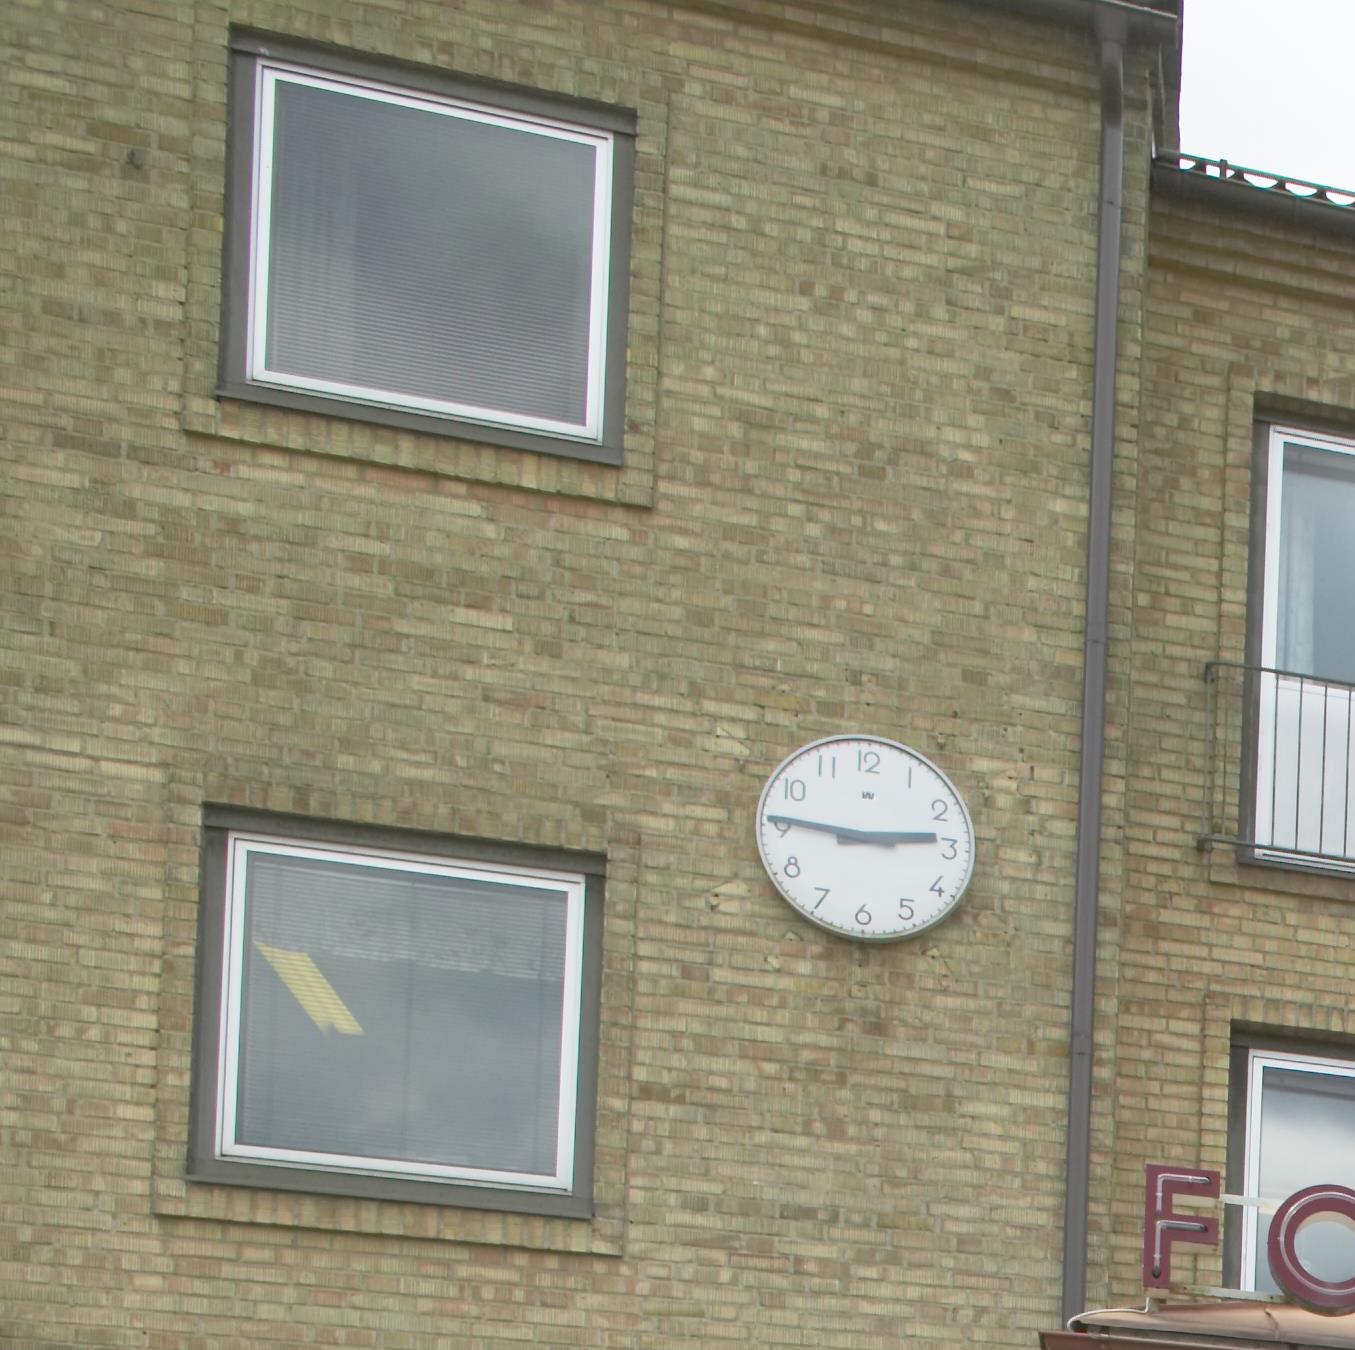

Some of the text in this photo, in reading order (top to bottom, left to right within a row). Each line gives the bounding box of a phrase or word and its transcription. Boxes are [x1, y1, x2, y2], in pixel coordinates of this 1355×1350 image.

[818, 754, 836, 779] 11
[858, 749, 881, 774] 12
[784, 777, 806, 801] 10
[931, 799, 949, 822] 2
[940, 837, 958, 860] 3
[783, 856, 801, 878] 8
[929, 875, 945, 897] 4
[813, 887, 830, 910] 7
[897, 898, 915, 921] 5
[855, 904, 872, 926] 6
